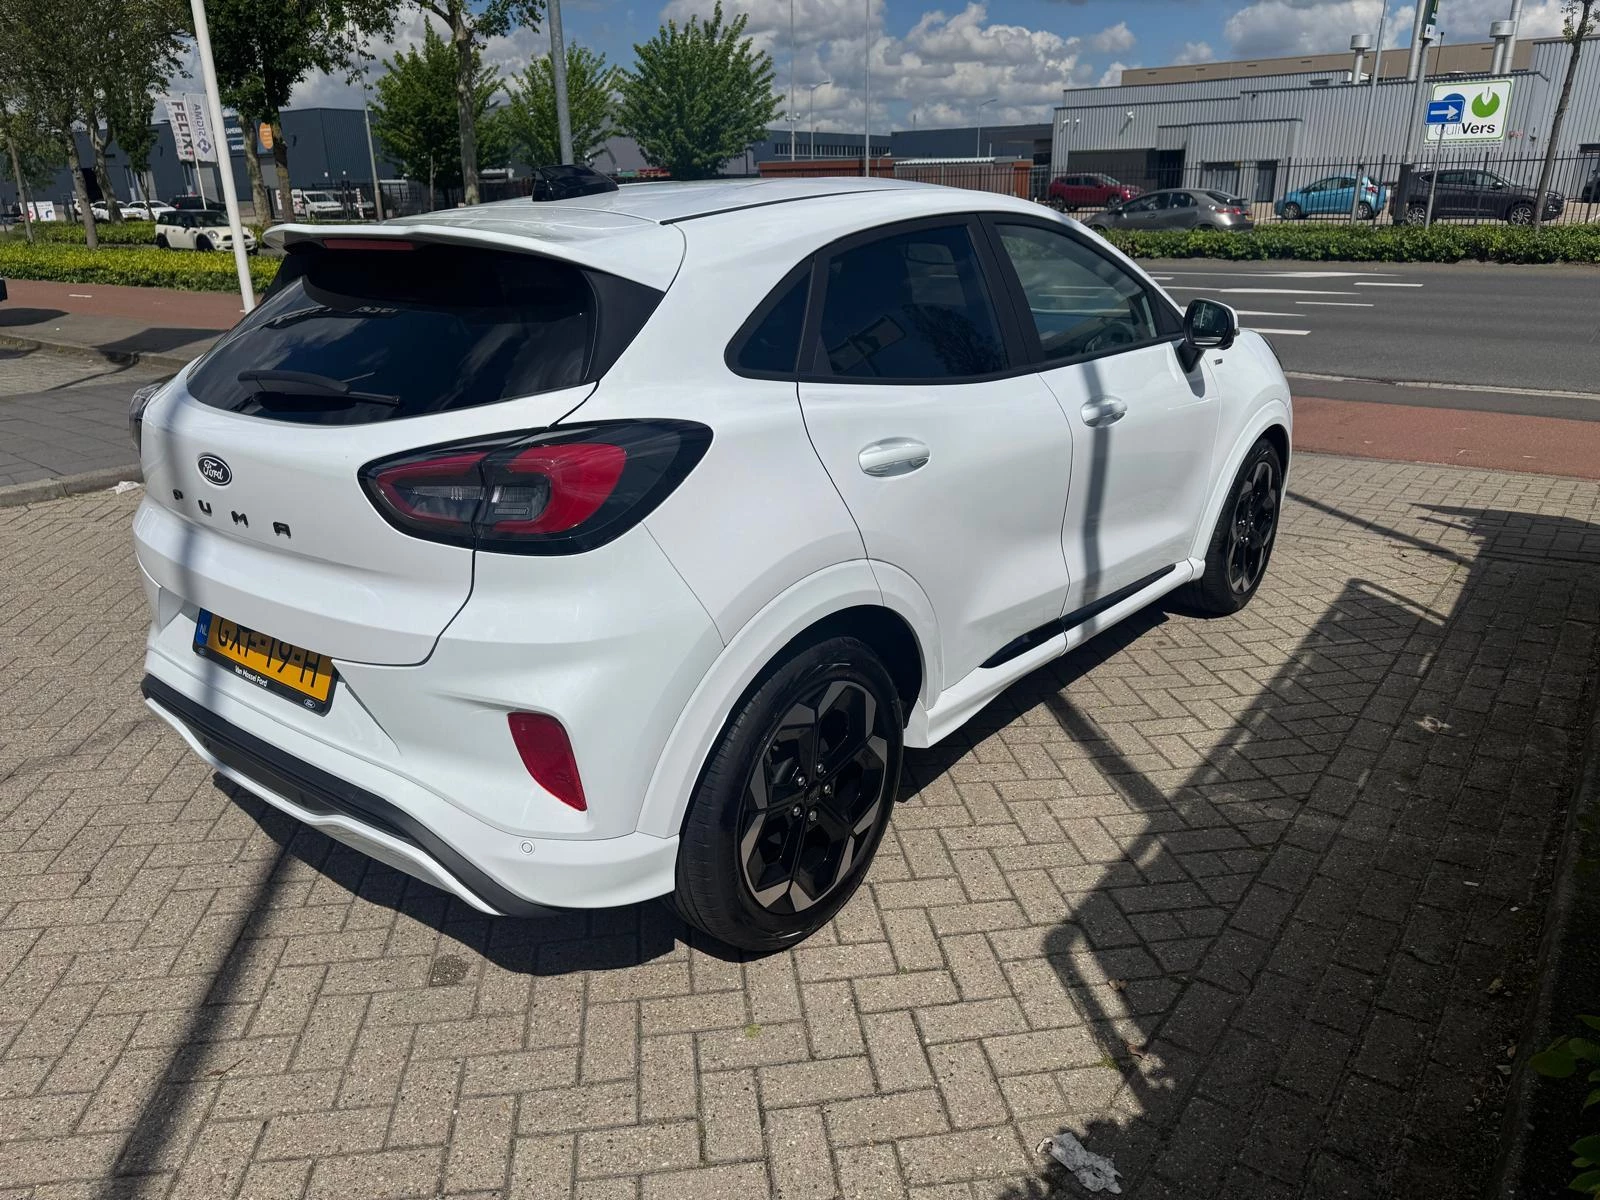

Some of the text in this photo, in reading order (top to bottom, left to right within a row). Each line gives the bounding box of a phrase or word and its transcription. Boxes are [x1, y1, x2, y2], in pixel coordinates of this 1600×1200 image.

[171, 102, 193, 149] FELIX
[203, 459, 224, 480] Ford
[172, 489, 292, 539] PUMA
[199, 623, 207, 636] NL
[234, 664, 243, 675] Van
[257, 675, 268, 687] Ford
